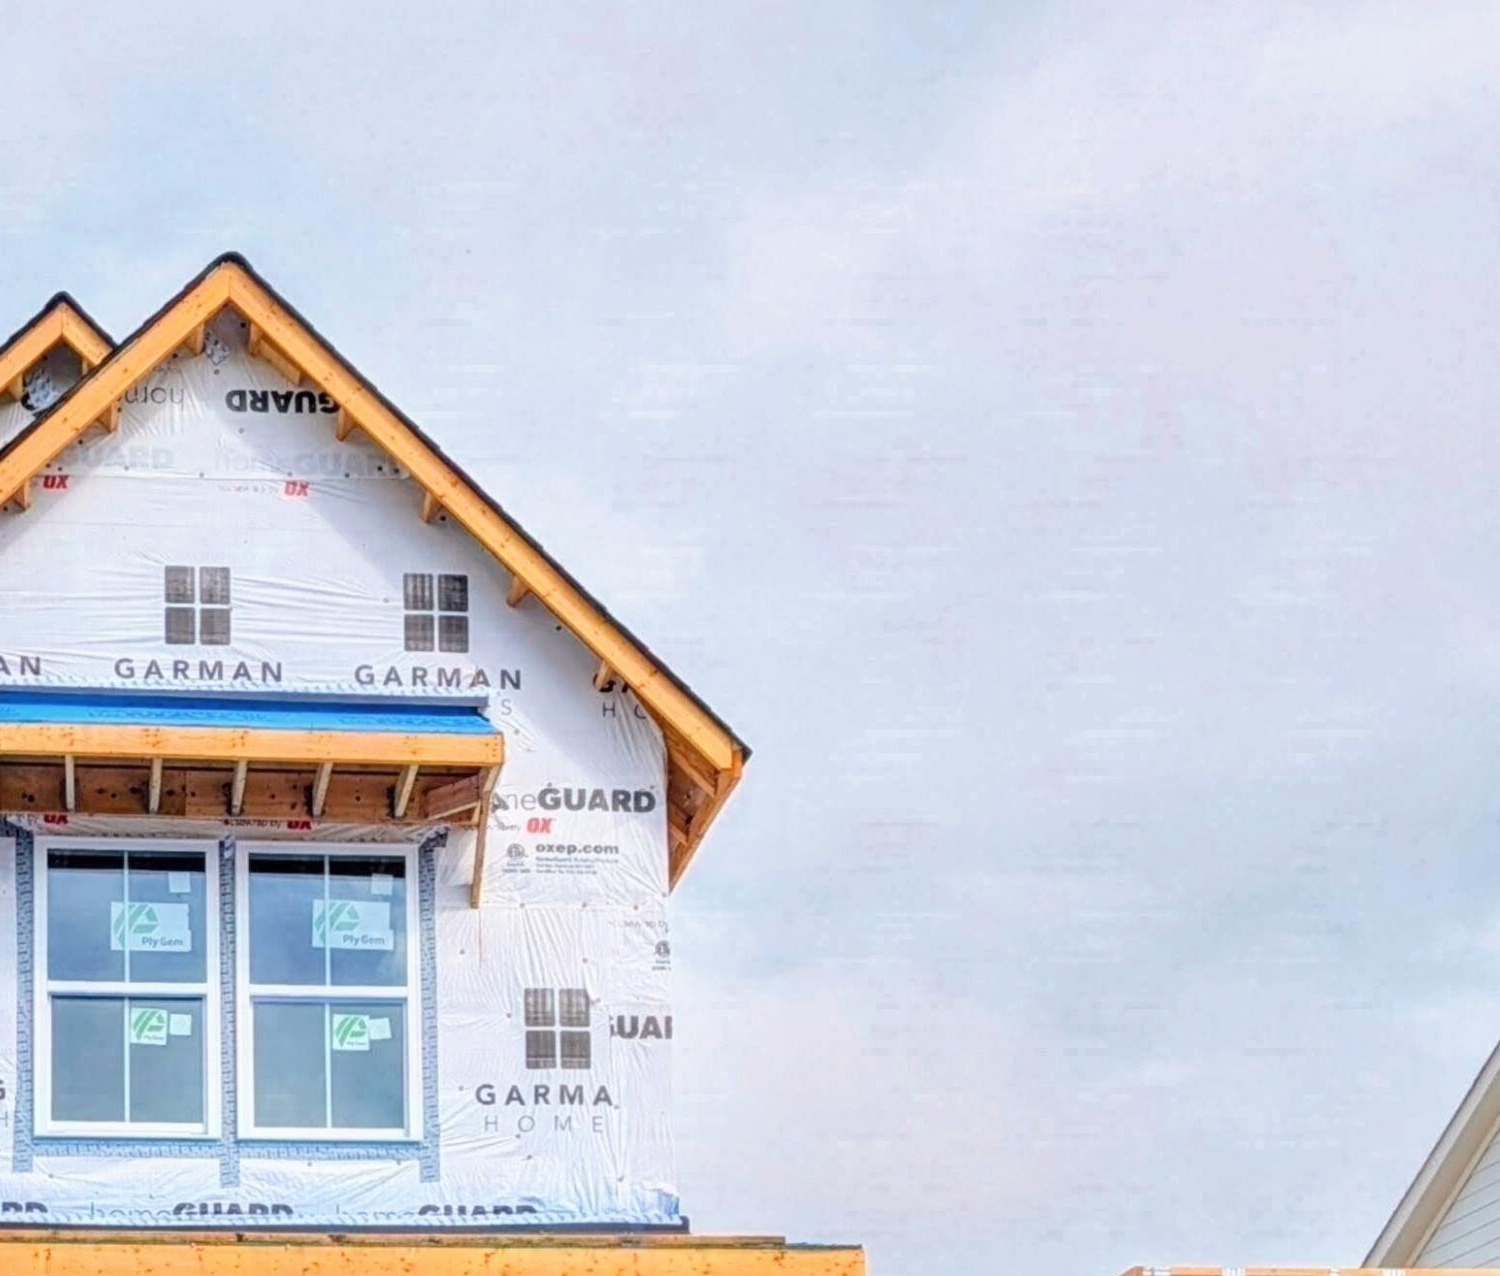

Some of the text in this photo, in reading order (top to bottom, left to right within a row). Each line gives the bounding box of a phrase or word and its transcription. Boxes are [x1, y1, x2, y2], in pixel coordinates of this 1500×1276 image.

[114, 657, 283, 682] GARMAN
[355, 664, 522, 690] GARMAN
[527, 817, 553, 834] OX
[535, 843, 620, 855] oxep.com
[141, 936, 184, 947] Ply Gem
[343, 934, 386, 946] Ply Gem
[475, 1084, 613, 1106] GARMA
[484, 1115, 604, 1133] HOME
